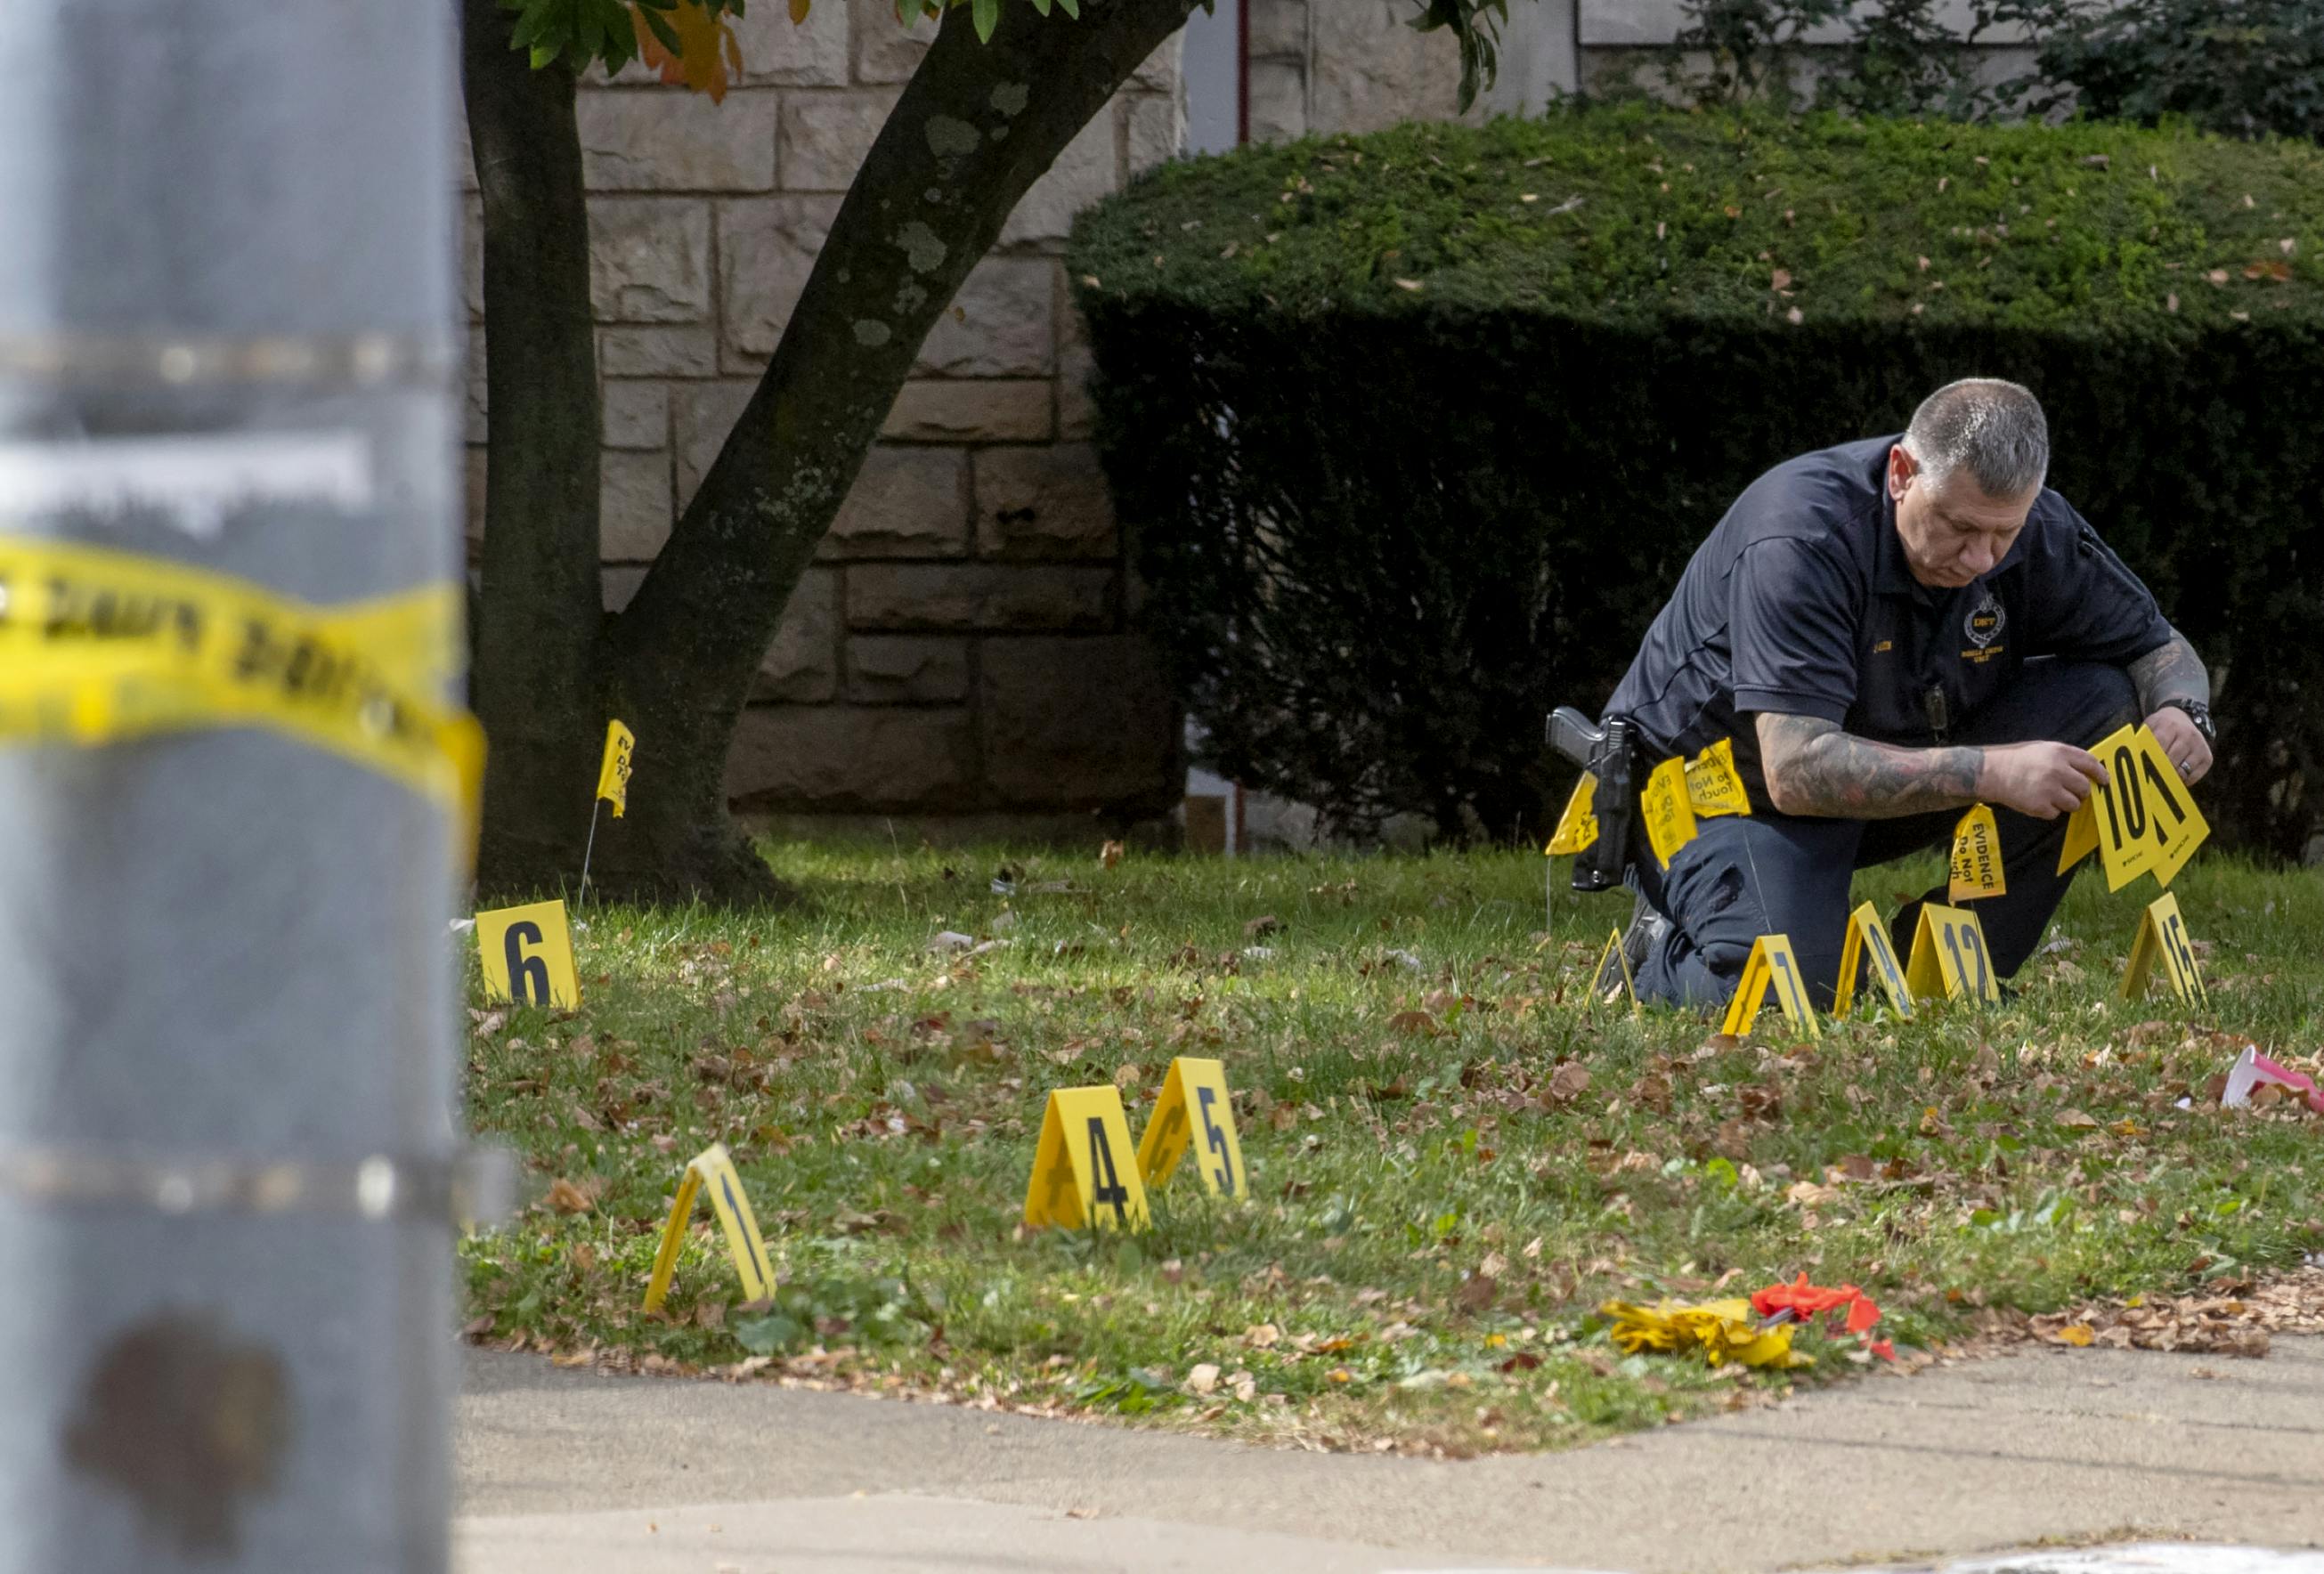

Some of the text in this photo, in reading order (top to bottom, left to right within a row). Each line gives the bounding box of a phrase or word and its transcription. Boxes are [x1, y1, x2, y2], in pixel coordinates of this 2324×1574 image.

[2097, 745, 2146, 851] 10
[1959, 837, 1974, 882] Do Not
[1973, 823, 1995, 889] EVIDENCE
[504, 921, 550, 1009] 6
[1774, 952, 1805, 1027] 7
[1944, 922, 1994, 1009] 12
[1087, 1116, 1129, 1226] 4
[1197, 1086, 1235, 1197] 5
[720, 1172, 764, 1284] 1
